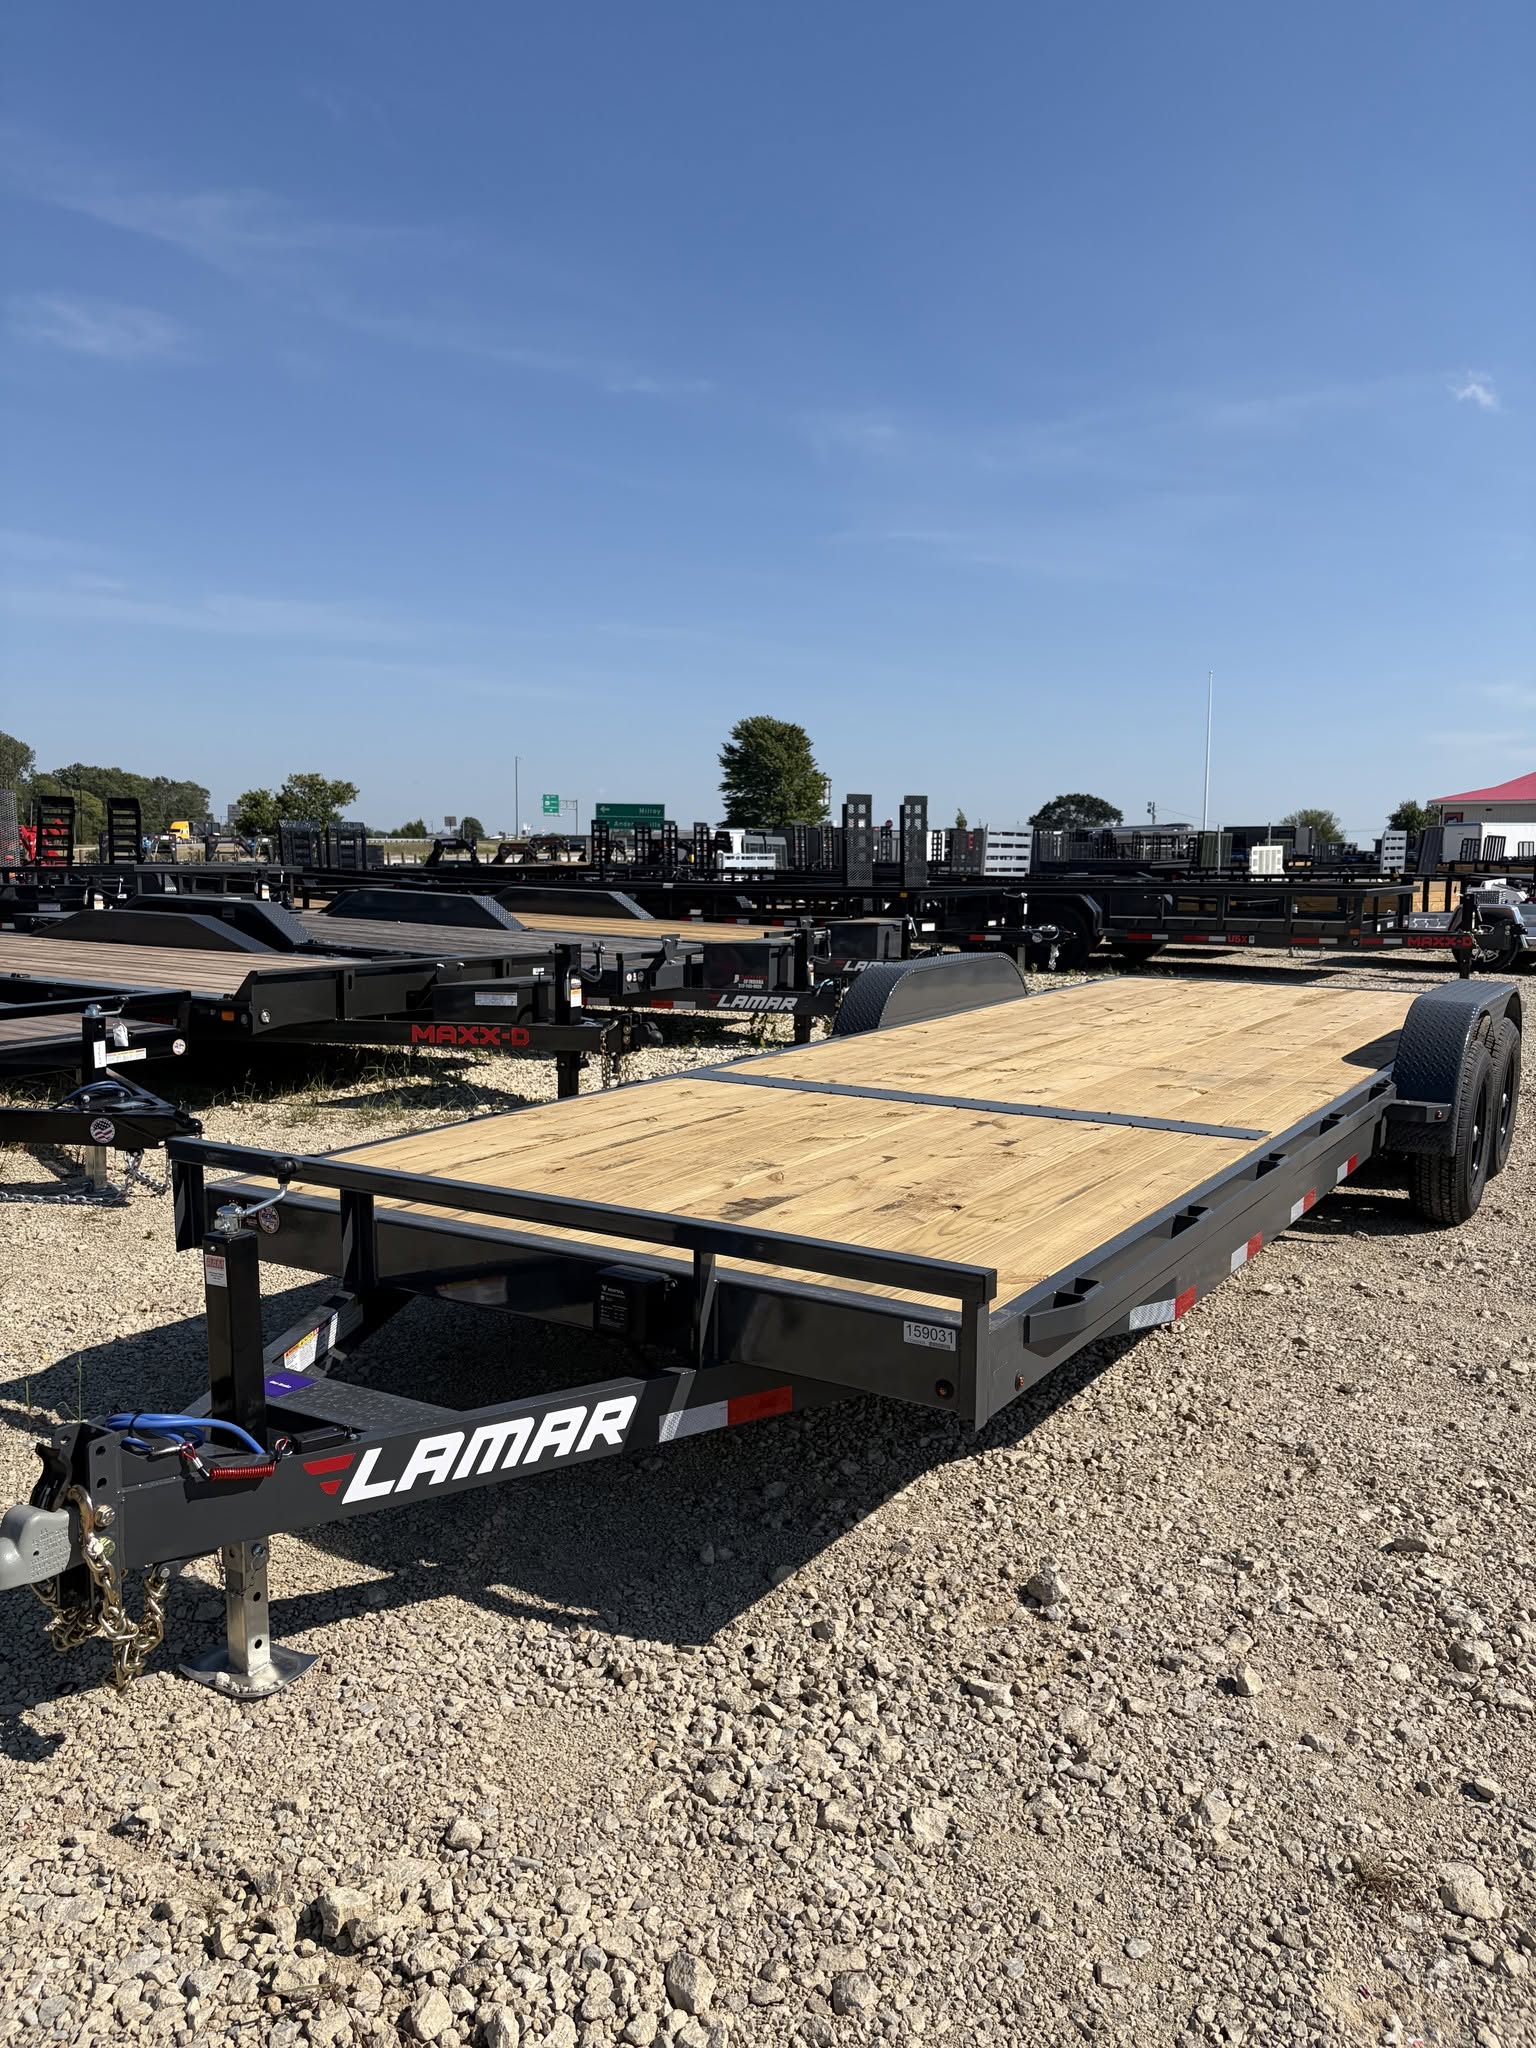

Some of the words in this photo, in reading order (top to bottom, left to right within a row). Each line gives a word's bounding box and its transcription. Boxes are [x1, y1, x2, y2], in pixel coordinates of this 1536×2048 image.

[1407, 936, 1473, 947] MAXX-D
[716, 994, 799, 1011] LAMAR
[412, 1024, 530, 1046] MAXX-D
[906, 1324, 953, 1344] 159031
[341, 1395, 638, 1505] LAMAR
